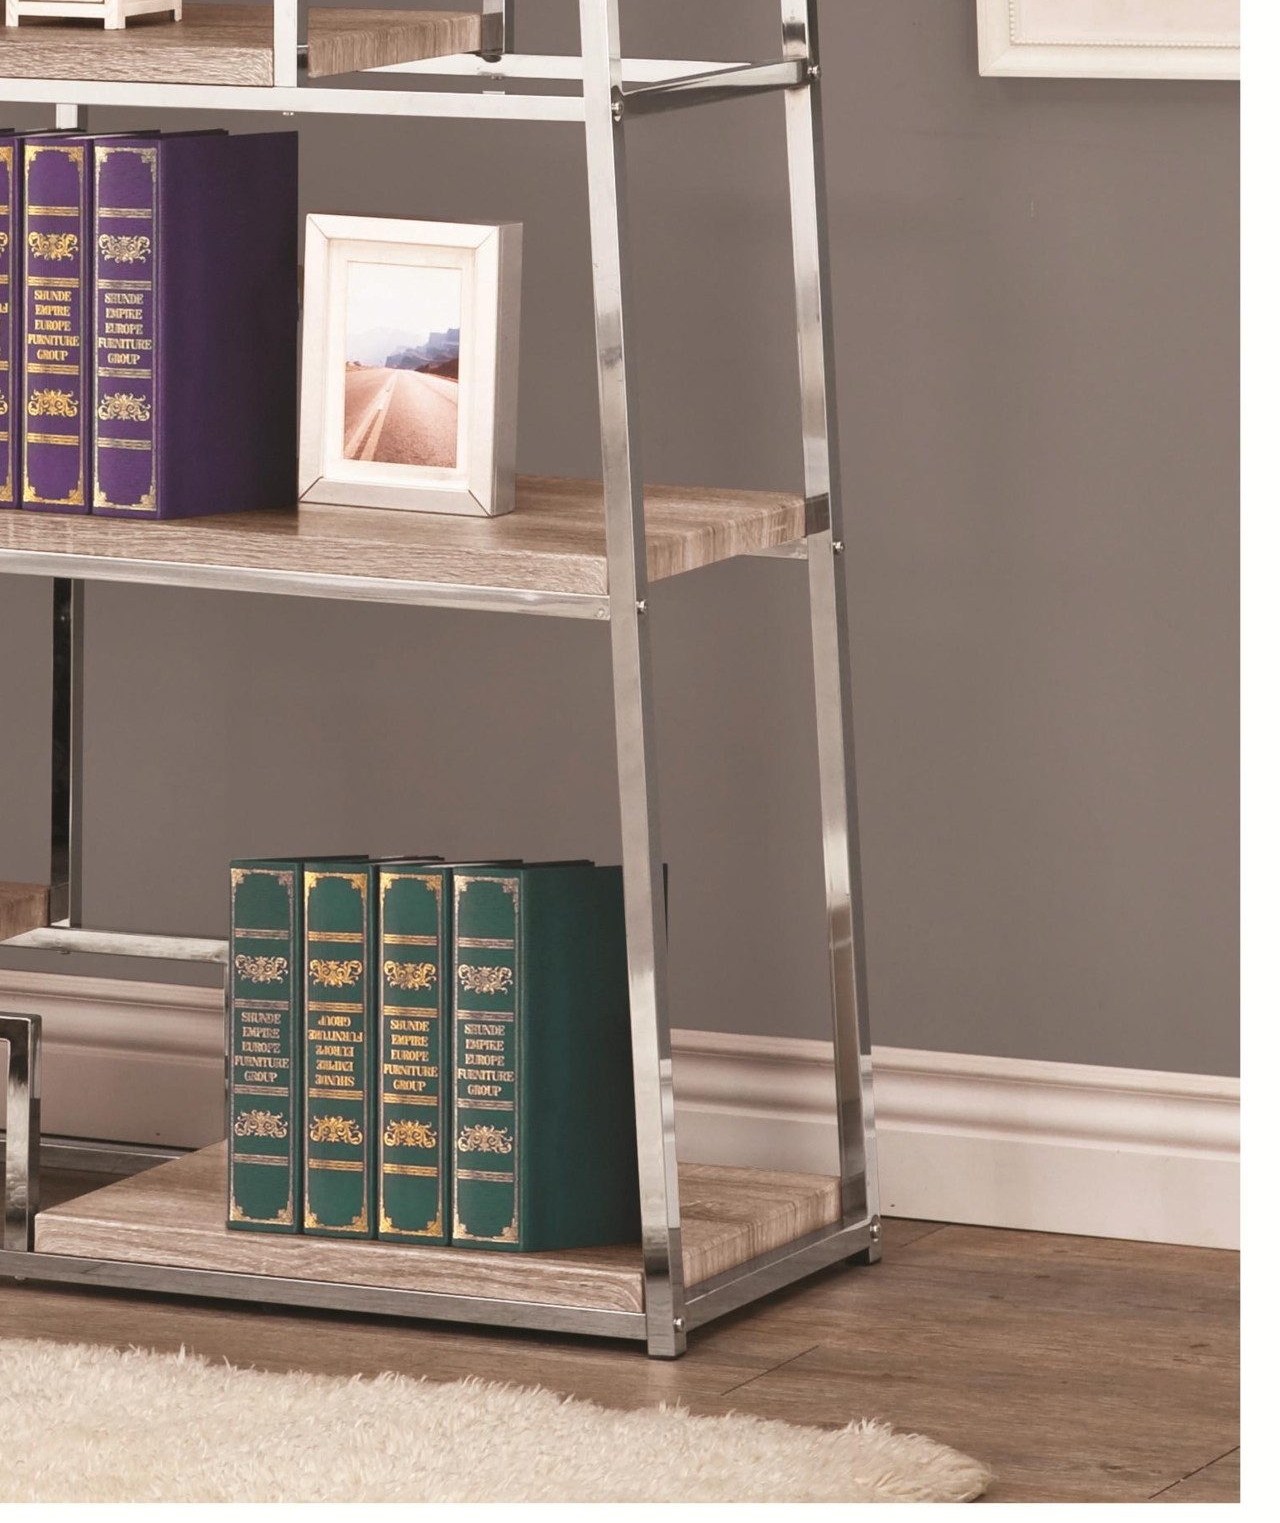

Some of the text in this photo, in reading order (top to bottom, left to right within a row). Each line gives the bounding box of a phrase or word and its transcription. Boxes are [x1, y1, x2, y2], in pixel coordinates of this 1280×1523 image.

[34, 290, 72, 302] SHUNDE
[104, 292, 144, 305] SHUNDE
[35, 304, 71, 317] EMPIRE
[105, 307, 143, 320] EMPIRE
[34, 319, 71, 332] EUROPE
[105, 322, 143, 335] EUROPE
[27, 333, 80, 347] FURNITURE
[98, 336, 152, 350] FURNITURE
[36, 349, 68, 361] GROUP
[107, 353, 141, 365] GROUP
[241, 1011, 281, 1025] SHUNDE
[390, 1019, 430, 1032] SHUNDE
[464, 1023, 506, 1036] SHUNDE
[242, 1026, 280, 1039] EMPIRE
[391, 1033, 429, 1047] EMPIRE
[465, 1038, 505, 1052] EMPIRE
[241, 1041, 281, 1054] EUROPE
[234, 1055, 290, 1069] FURNITURE
[390, 1049, 429, 1062] EUROPE
[464, 1053, 505, 1066] EUROPE
[244, 1070, 278, 1083] GROUP
[383, 1063, 438, 1077] FURNITURE
[457, 1067, 514, 1082] FURNITURE
[393, 1079, 426, 1092] GROUP
[467, 1084, 502, 1097] GROUP
